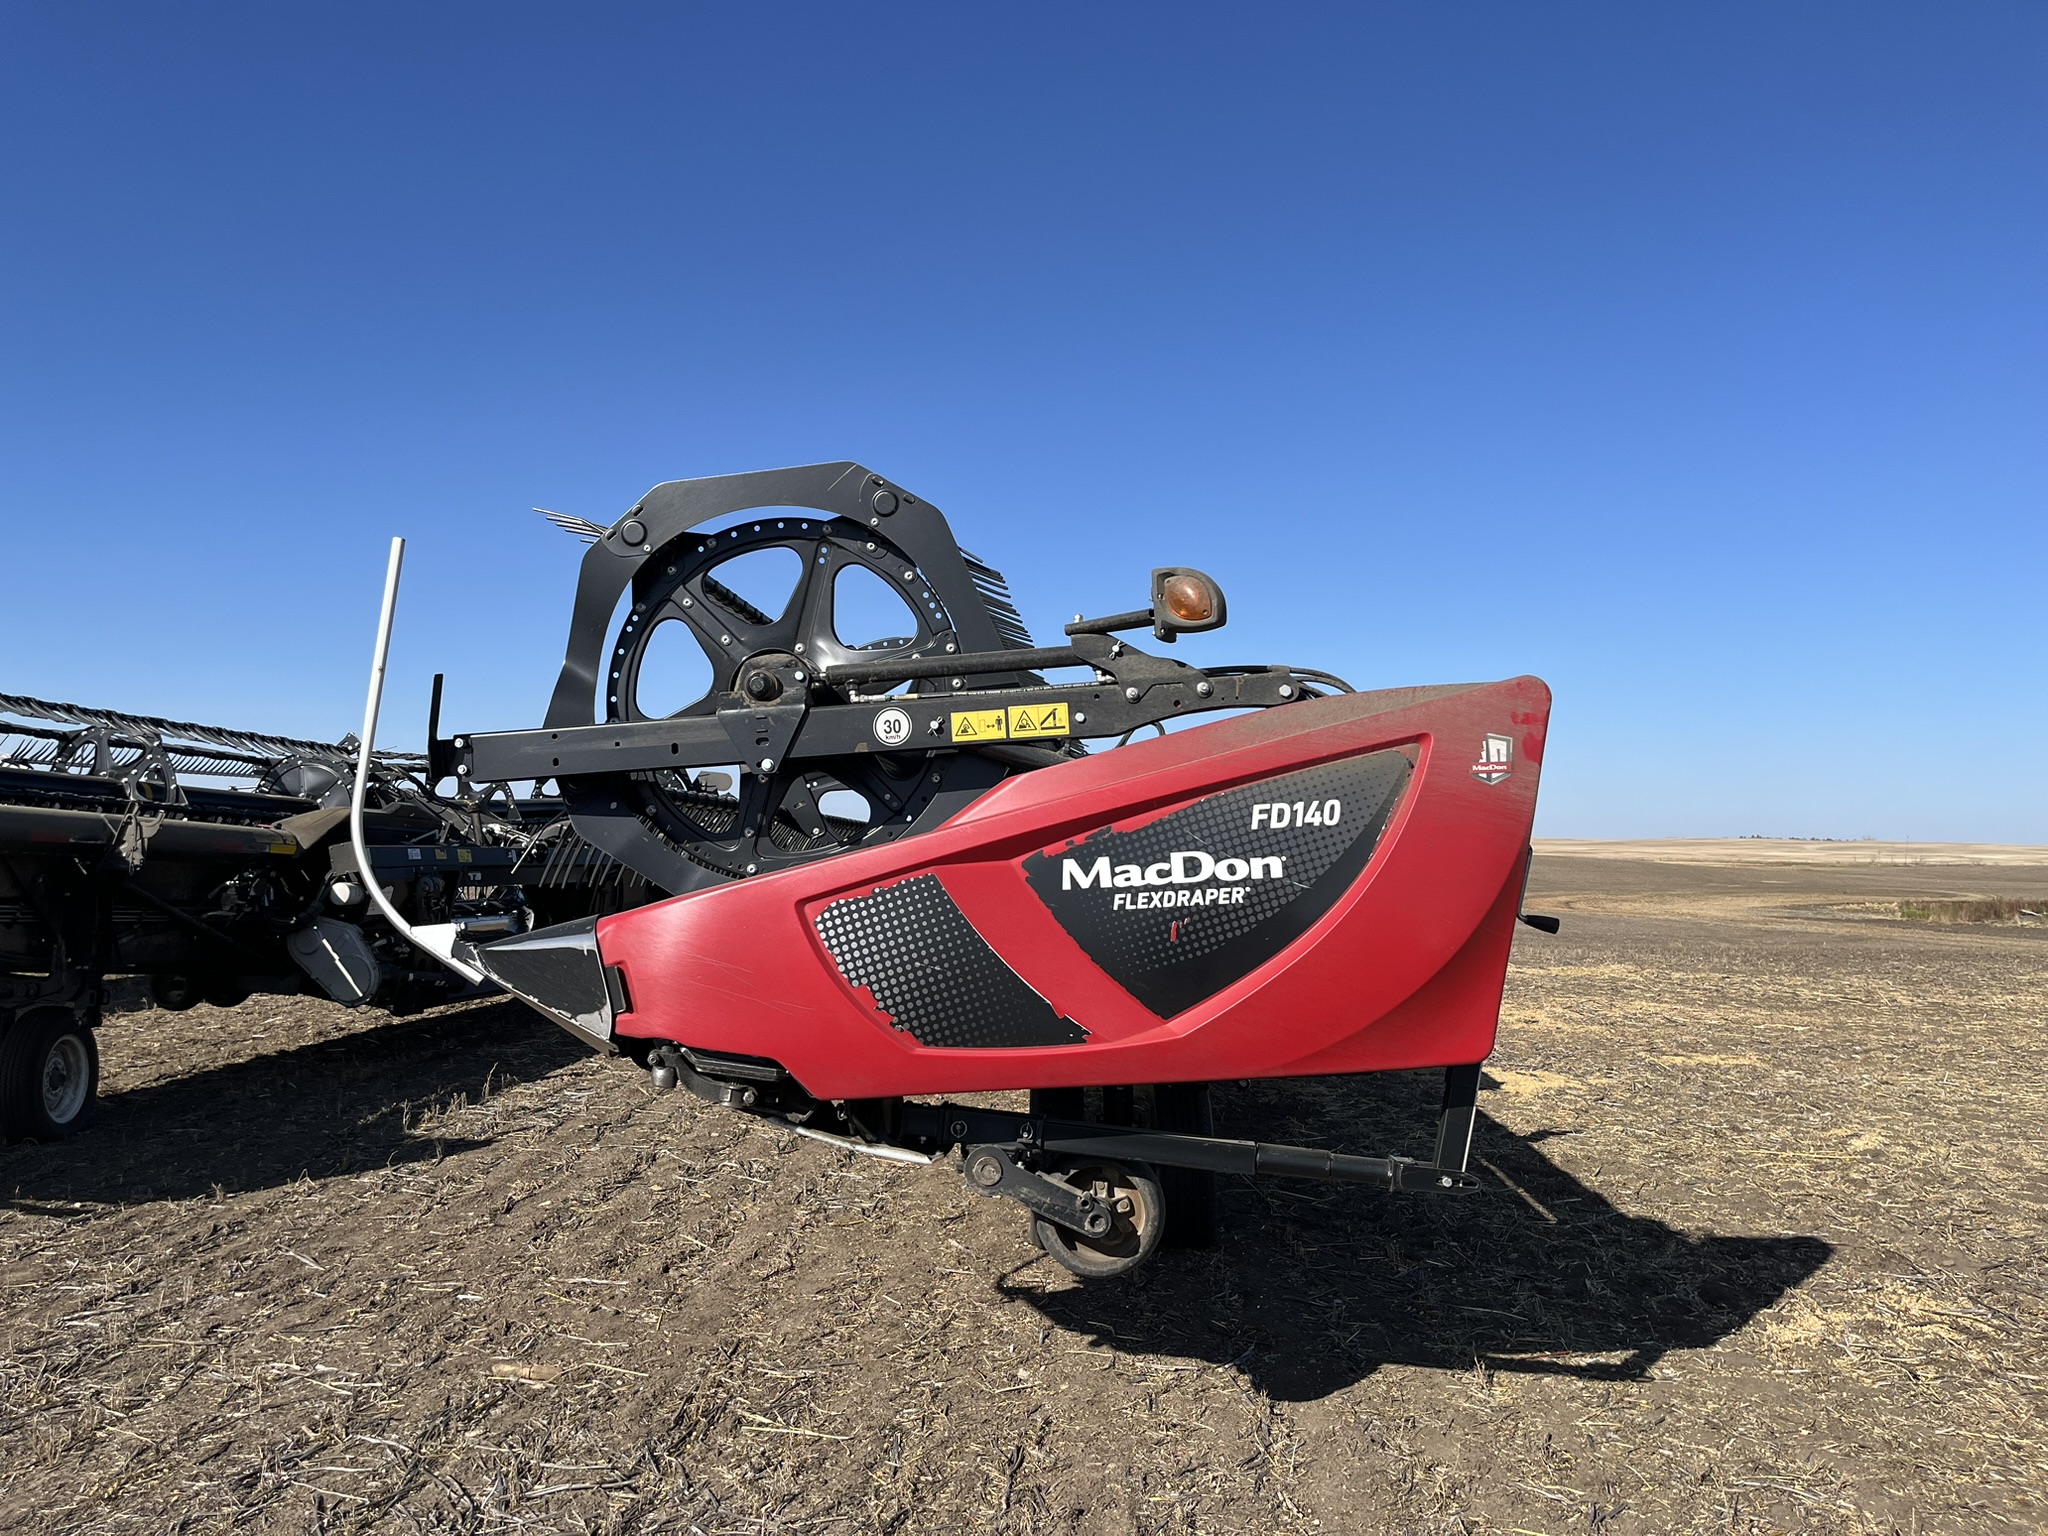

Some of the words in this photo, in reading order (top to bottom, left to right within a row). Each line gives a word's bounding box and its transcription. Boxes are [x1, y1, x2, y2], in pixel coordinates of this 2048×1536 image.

[883, 719, 902, 734] 30
[1251, 799, 1341, 830] FD140
[1061, 851, 1284, 891] MacDon
[1113, 887, 1245, 910] FLEXDRAPER
